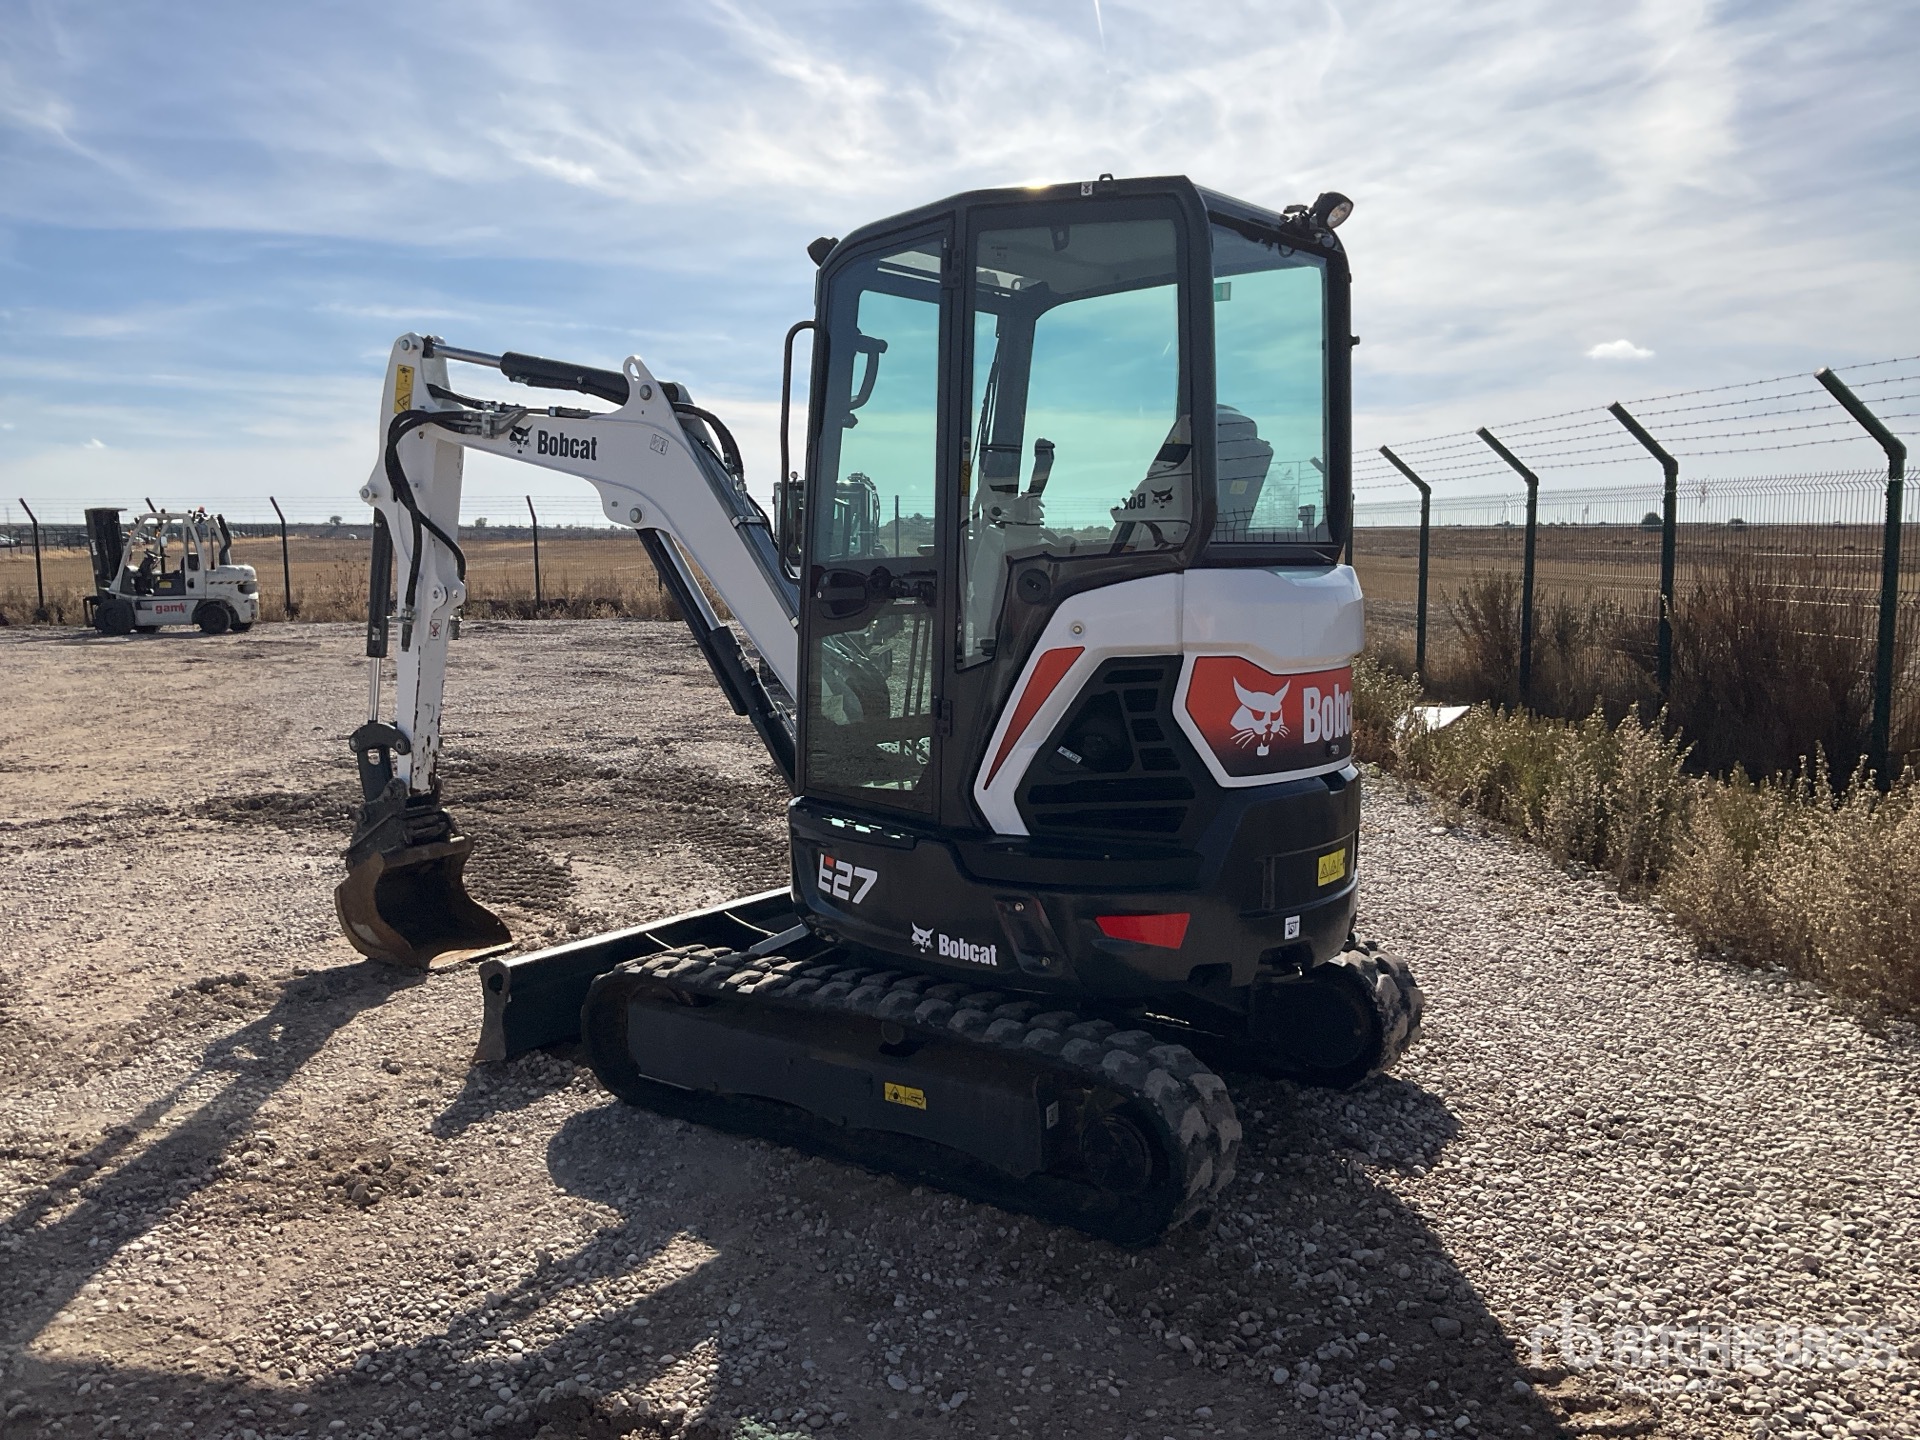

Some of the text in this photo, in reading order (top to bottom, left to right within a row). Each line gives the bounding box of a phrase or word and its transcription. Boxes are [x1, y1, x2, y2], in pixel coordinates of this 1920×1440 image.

[538, 430, 597, 461] Bobcat
[1303, 683, 1352, 744] Bobc
[817, 852, 878, 904] E27
[938, 933, 998, 967] Bobcat
